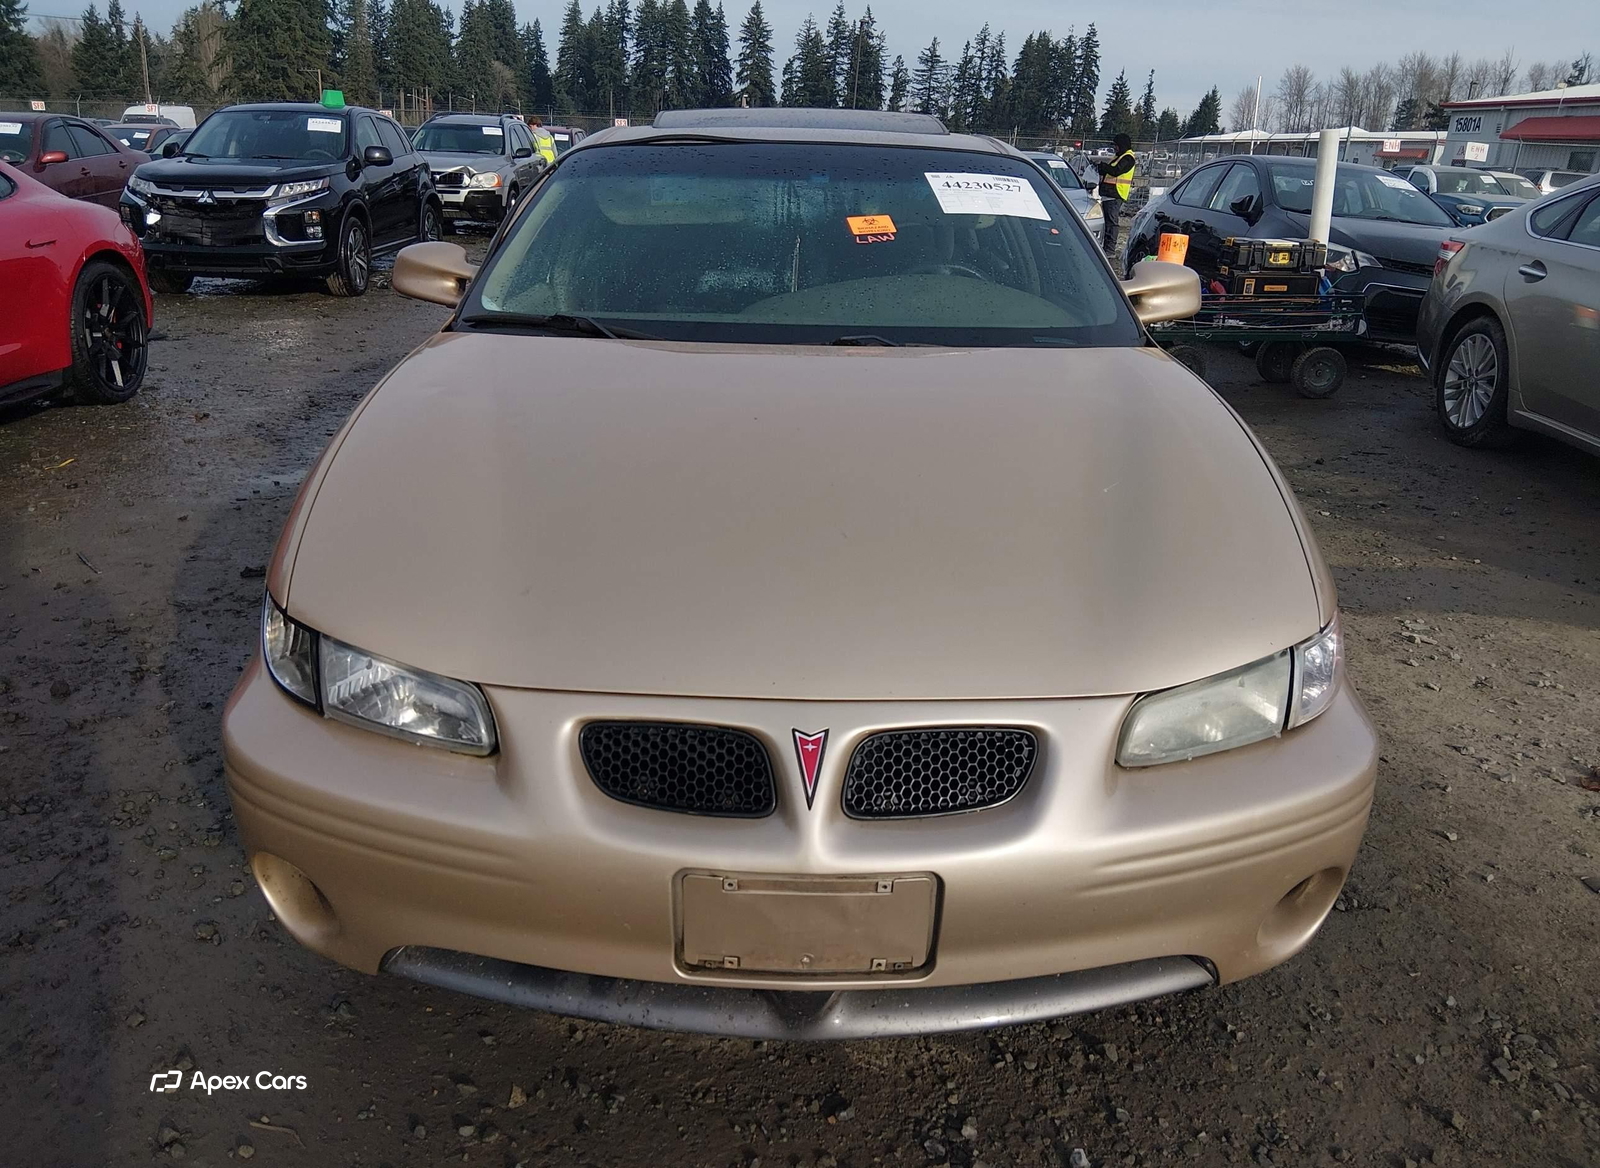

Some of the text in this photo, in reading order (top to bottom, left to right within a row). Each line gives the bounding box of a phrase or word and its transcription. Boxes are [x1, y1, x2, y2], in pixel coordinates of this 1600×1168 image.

[1455, 117, 1481, 132] 15801A
[1385, 140, 1400, 150] ENH
[942, 181, 1021, 192] 44230527
[856, 233, 895, 243] LAW
